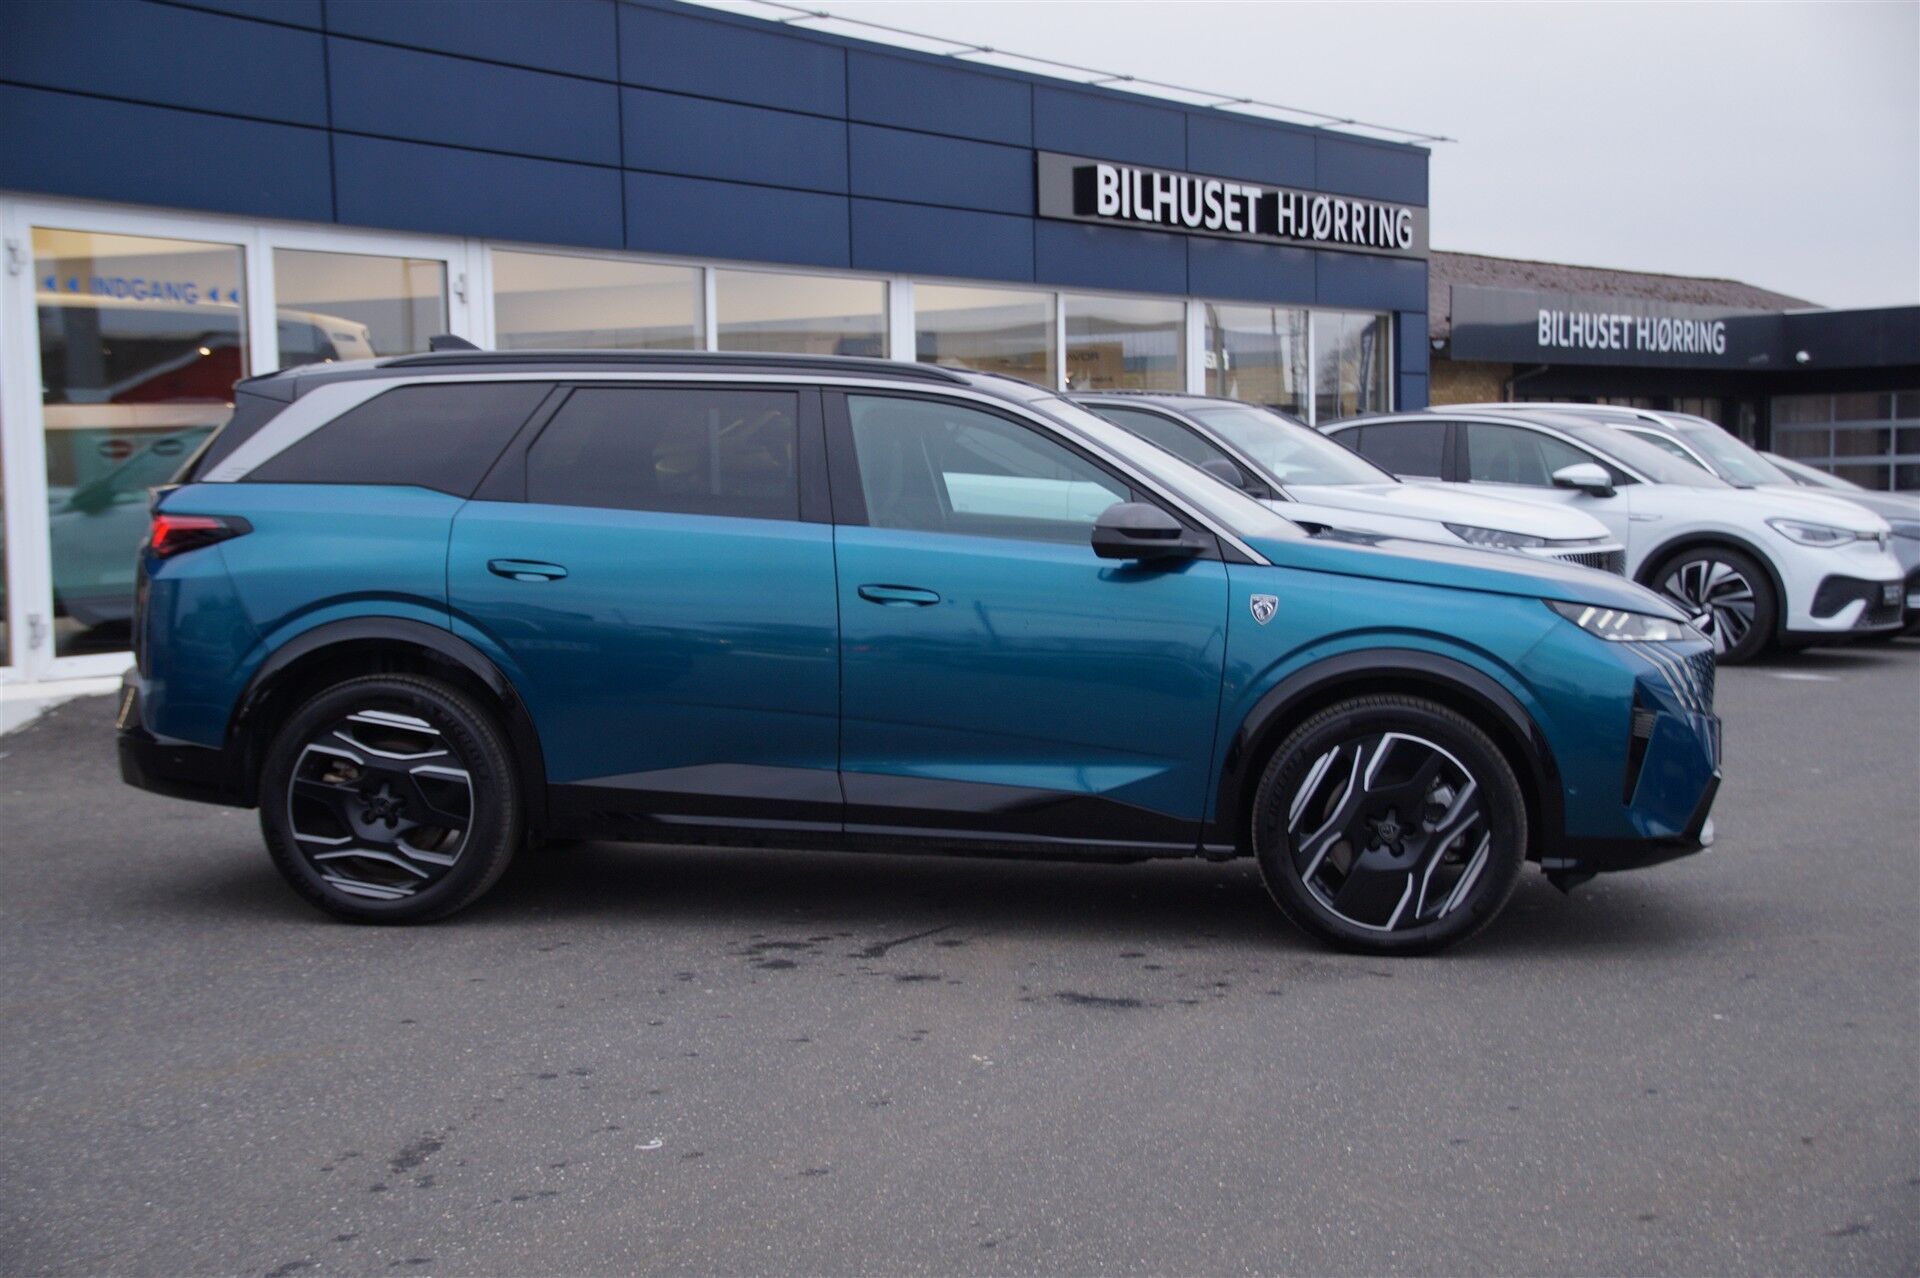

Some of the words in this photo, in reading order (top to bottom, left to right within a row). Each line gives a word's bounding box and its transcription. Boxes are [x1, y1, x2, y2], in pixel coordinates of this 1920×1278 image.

[1097, 163, 1262, 234] BILHUSET
[1277, 191, 1413, 250] HJØRRING
[89, 276, 200, 304] INDGANG
[1538, 309, 1632, 350] BILHUSET
[1636, 317, 1726, 355] HJØRRING
